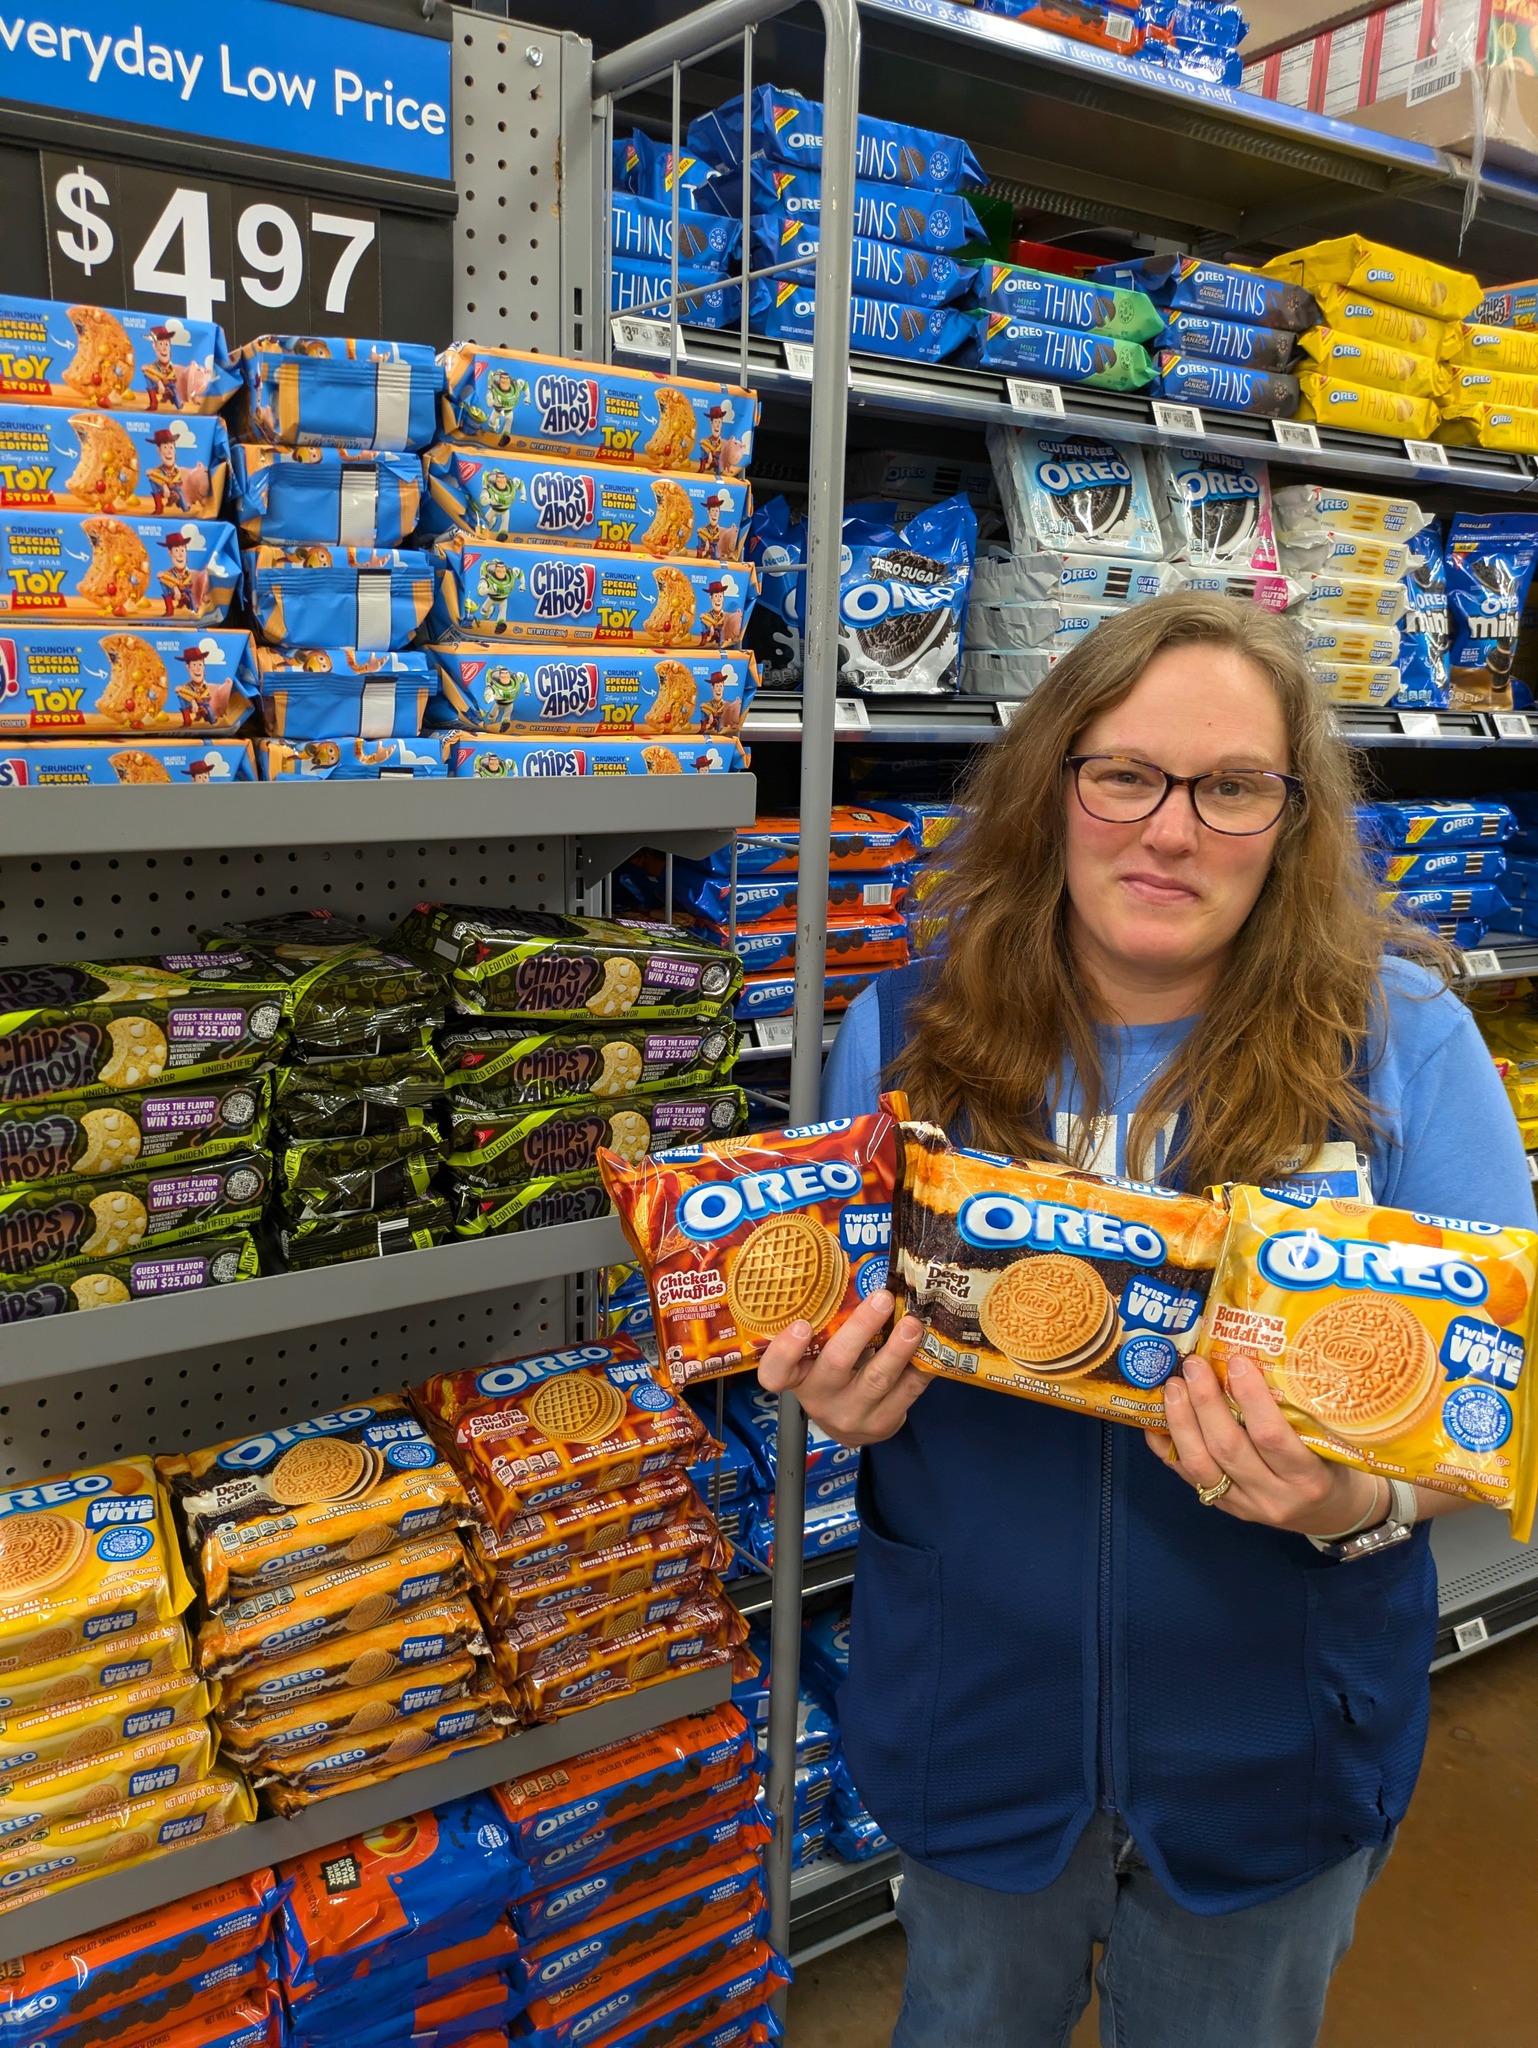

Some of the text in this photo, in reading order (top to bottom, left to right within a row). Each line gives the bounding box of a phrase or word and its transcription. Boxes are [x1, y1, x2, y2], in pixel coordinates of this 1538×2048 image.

[220, 45, 315, 110] Low
[335, 69, 446, 135] Price
[1139, 66, 1166, 87] the
[1169, 75, 1195, 94] top
[1367, 270, 1394, 281] OREO
[1004, 279, 1093, 327] OREO THINS
[1018, 298, 1036, 306] MINT
[1193, 271, 1265, 316] OREO THINS
[1345, 305, 1374, 317] OREO
[1178, 318, 1254, 359] OREO THINS
[1472, 335, 1500, 346] OREO
[1006, 326, 1093, 373] OREO THINS
[1333, 346, 1361, 358] OREO
[538, 375, 588, 407] Chips
[1177, 364, 1251, 404] OREO THINS
[1462, 375, 1491, 387] OREO
[605, 397, 640, 410] SPECIAL
[607, 390, 639, 399] CRUNCHY
[1330, 392, 1358, 404] OREO
[606, 406, 640, 417] EDITION
[601, 427, 640, 450] TOY
[1039, 441, 1114, 456] GLUTEN FREE
[601, 449, 632, 460] STORY
[1181, 450, 1243, 469] GLUTEN FREE
[1039, 460, 1131, 491] OREO
[1183, 471, 1260, 500] OREO
[534, 474, 585, 503] Chips
[1389, 505, 1408, 514] GOLDEN
[1384, 516, 1406, 524] GLUTEN
[1385, 523, 1402, 531] FREE
[11, 526, 56, 535] CRUNCHY
[11, 547, 61, 556] EDITION
[764, 555, 788, 566] New!
[872, 557, 901, 575] ZERO
[1061, 568, 1097, 583] OREO
[8, 569, 67, 595] TOY
[533, 562, 585, 591] Chips
[16, 596, 61, 606] STORY
[843, 582, 954, 621] OREO
[597, 608, 637, 628] TOY
[1469, 615, 1519, 638] mini
[599, 629, 631, 638] STORY
[30, 646, 75, 654] CRUNCHY
[27, 656, 79, 665] SPECIAL
[29, 664, 79, 674] EDITION
[536, 664, 587, 693] Chips
[27, 688, 84, 712] TOY
[35, 713, 79, 724] STORY
[1443, 817, 1474, 833] OREO
[1425, 856, 1457, 871] OREO
[1407, 893, 1442, 907] OREO
[735, 937, 782, 954] OREO
[648, 971, 695, 986] WIN $25,000
[749, 986, 794, 1005] OREO
[173, 1013, 198, 1021] GUESS
[214, 1013, 242, 1021] FLAVOR
[173, 1026, 241, 1037] WIN $25,000
[655, 1116, 705, 1127] WIN $25,000
[784, 1118, 852, 1139] OREO
[153, 1184, 176, 1192] GUESS
[191, 1179, 218, 1188] FLAVOR
[1103, 1177, 1180, 1197] OREO
[152, 1191, 217, 1207] WIN $25,000
[681, 1161, 859, 1236] OREO
[963, 1194, 1164, 1264] OREO
[1414, 1213, 1503, 1234] OREO
[844, 1223, 892, 1246] VOT
[928, 1266, 969, 1286] Deep
[1262, 1233, 1486, 1302] OREO
[660, 1270, 718, 1291] Chicken
[925, 1278, 970, 1299] Fried
[1133, 1281, 1197, 1310] TWIST LICK
[1126, 1292, 1193, 1329] VOTE
[1215, 1305, 1284, 1332] Banana
[1212, 1321, 1286, 1354] Pudding
[1500, 1340, 1524, 1357] LICK
[478, 1346, 611, 1394] OREO
[1448, 1339, 1521, 1383] VOTE
[986, 1374, 1086, 1405] LIMITED EDITION FLAVORS
[1013, 1374, 1033, 1383] TRY
[1034, 1380, 1050, 1390] ALL
[1111, 1395, 1147, 1411] SANDWICH
[472, 1410, 521, 1426] Chicken
[220, 1408, 374, 1466] OREO
[368, 1424, 423, 1442] VOTE
[1435, 1462, 1509, 1488] SANDWICH COOKIES
[91, 1507, 154, 1523] VOTE
[92, 1501, 128, 1509] TWIST
[511, 1543, 569, 1569] OREO
[259, 1668, 326, 1693] OREO
[128, 1679, 180, 1703] NET WT 10.68 OZ
[126, 1715, 172, 1734] VOTE
[534, 1800, 600, 1840] OREO
[2, 1857, 76, 1887] OREO
[326, 1866, 336, 1886] PACK
[332, 1863, 343, 1885] DARK
[341, 1867, 350, 1885] THE
[345, 1857, 356, 1881] GLOW
[545, 1878, 607, 1918] OREO
[97, 1928, 130, 1949] SANDWICH
[131, 1919, 157, 1936] COOKIES
[540, 1941, 603, 1982] OREO
[570, 1994, 629, 2038] OREO
